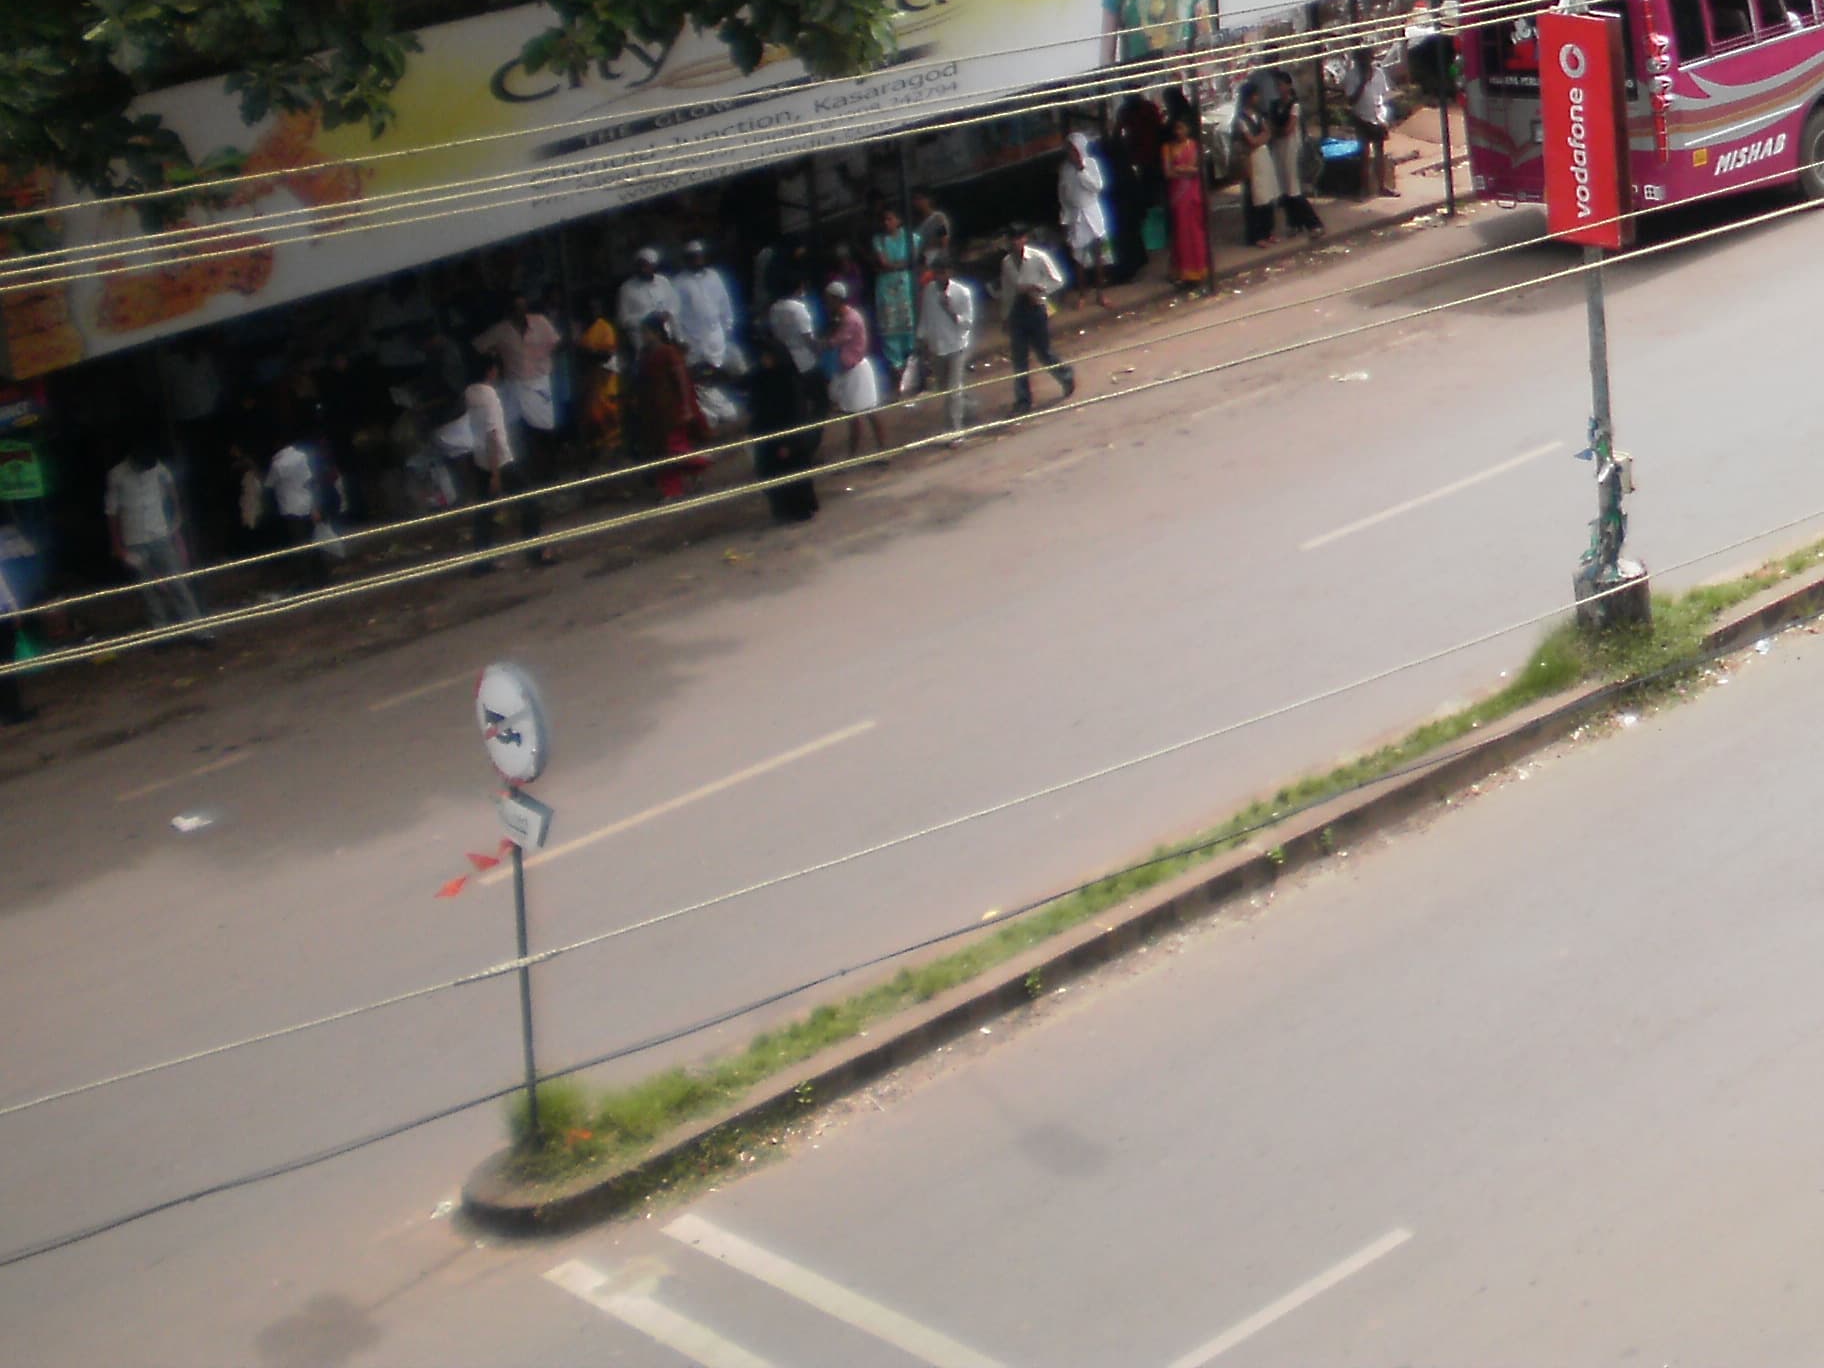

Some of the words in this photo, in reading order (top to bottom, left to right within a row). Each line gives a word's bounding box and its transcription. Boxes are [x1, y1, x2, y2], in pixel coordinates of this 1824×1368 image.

[813, 62, 958, 113] Kasaragod
[1566, 87, 1592, 219] vodafone
[1714, 133, 1787, 177] MISHAB
